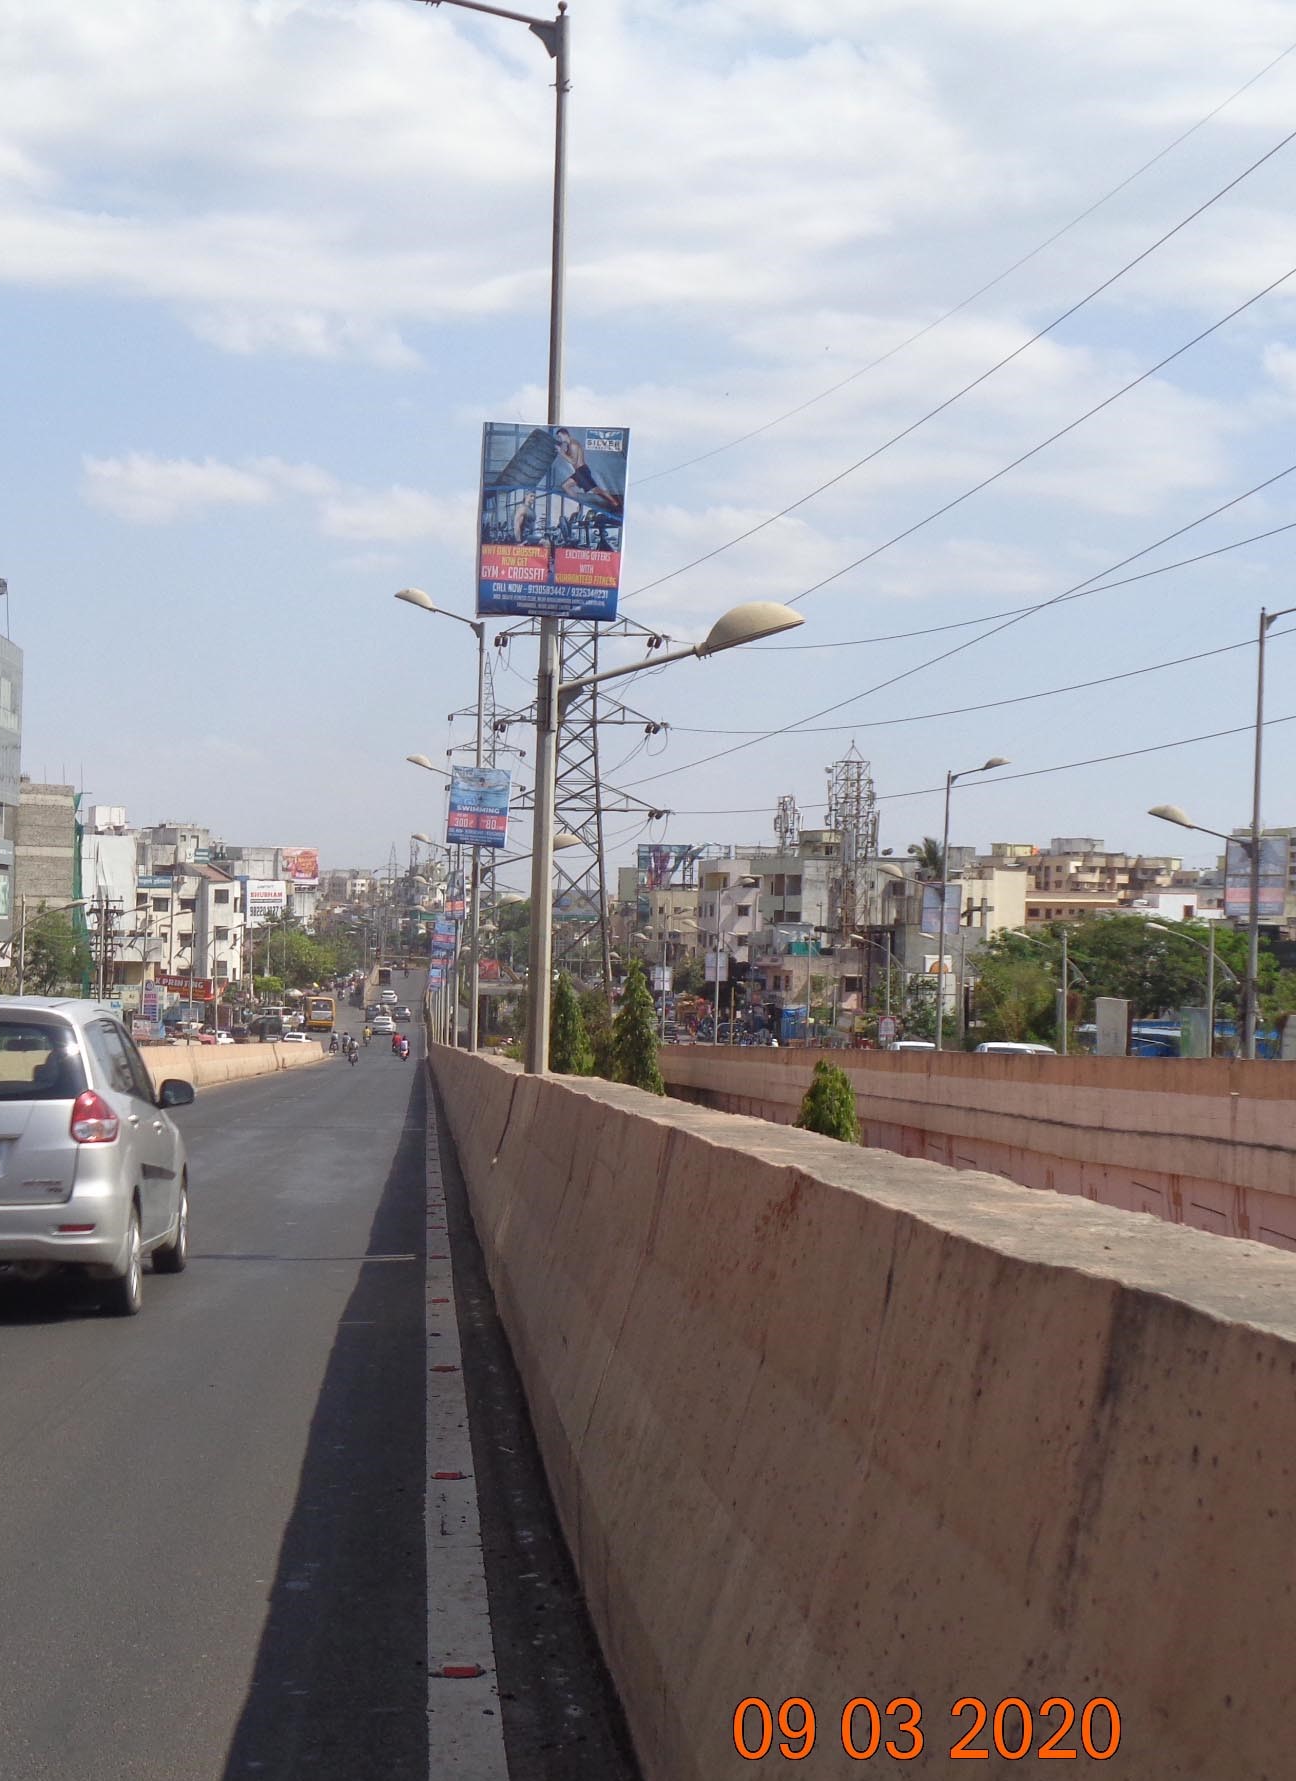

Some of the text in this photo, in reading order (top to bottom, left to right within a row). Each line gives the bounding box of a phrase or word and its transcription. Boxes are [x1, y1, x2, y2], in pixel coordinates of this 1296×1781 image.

[481, 565, 499, 578] GYM
[507, 566, 544, 580] CROSSFIT
[492, 582, 506, 593] CALL
[507, 583, 523, 593] NOW
[456, 805, 500, 814] SWIMMING
